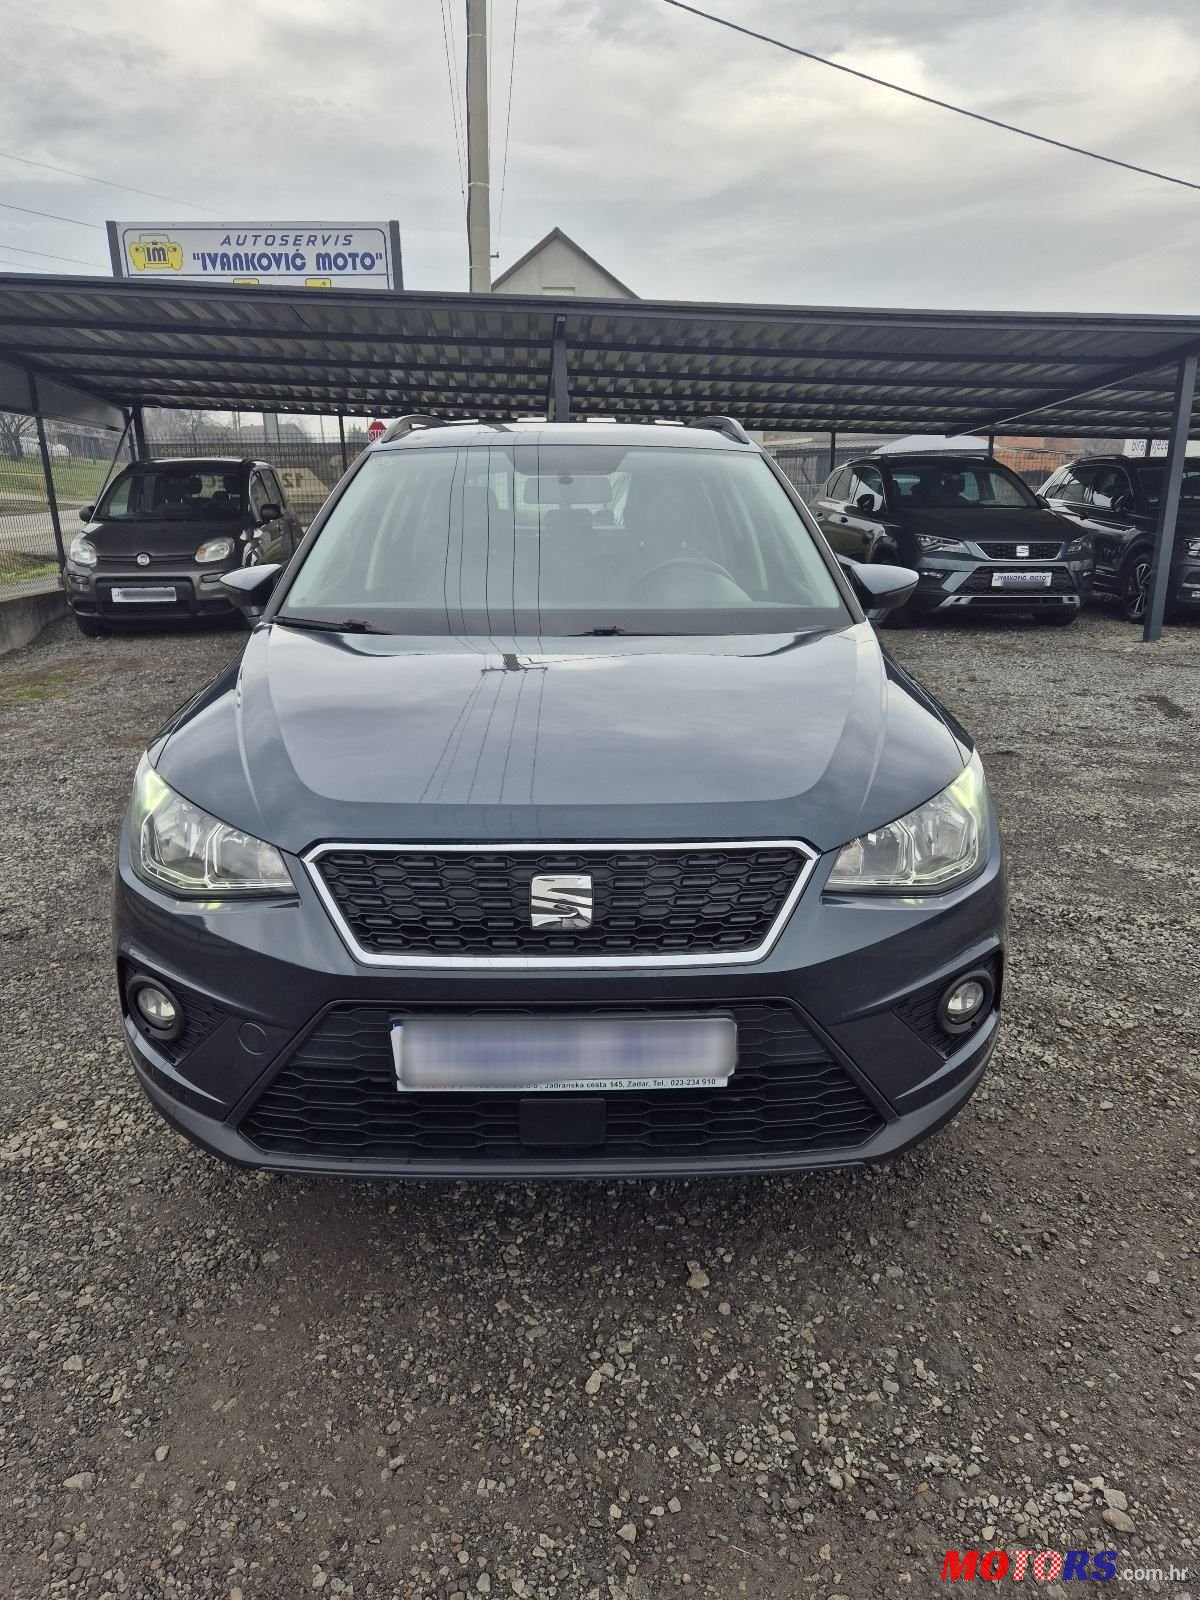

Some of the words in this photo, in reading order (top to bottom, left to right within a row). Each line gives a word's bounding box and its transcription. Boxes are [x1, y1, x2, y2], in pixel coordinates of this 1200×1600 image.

[220, 234, 354, 247] AUTOSERVIS
[146, 246, 167, 262] IM
[315, 252, 383, 271] MOTO"
[701, 1078, 716, 1086] 910
